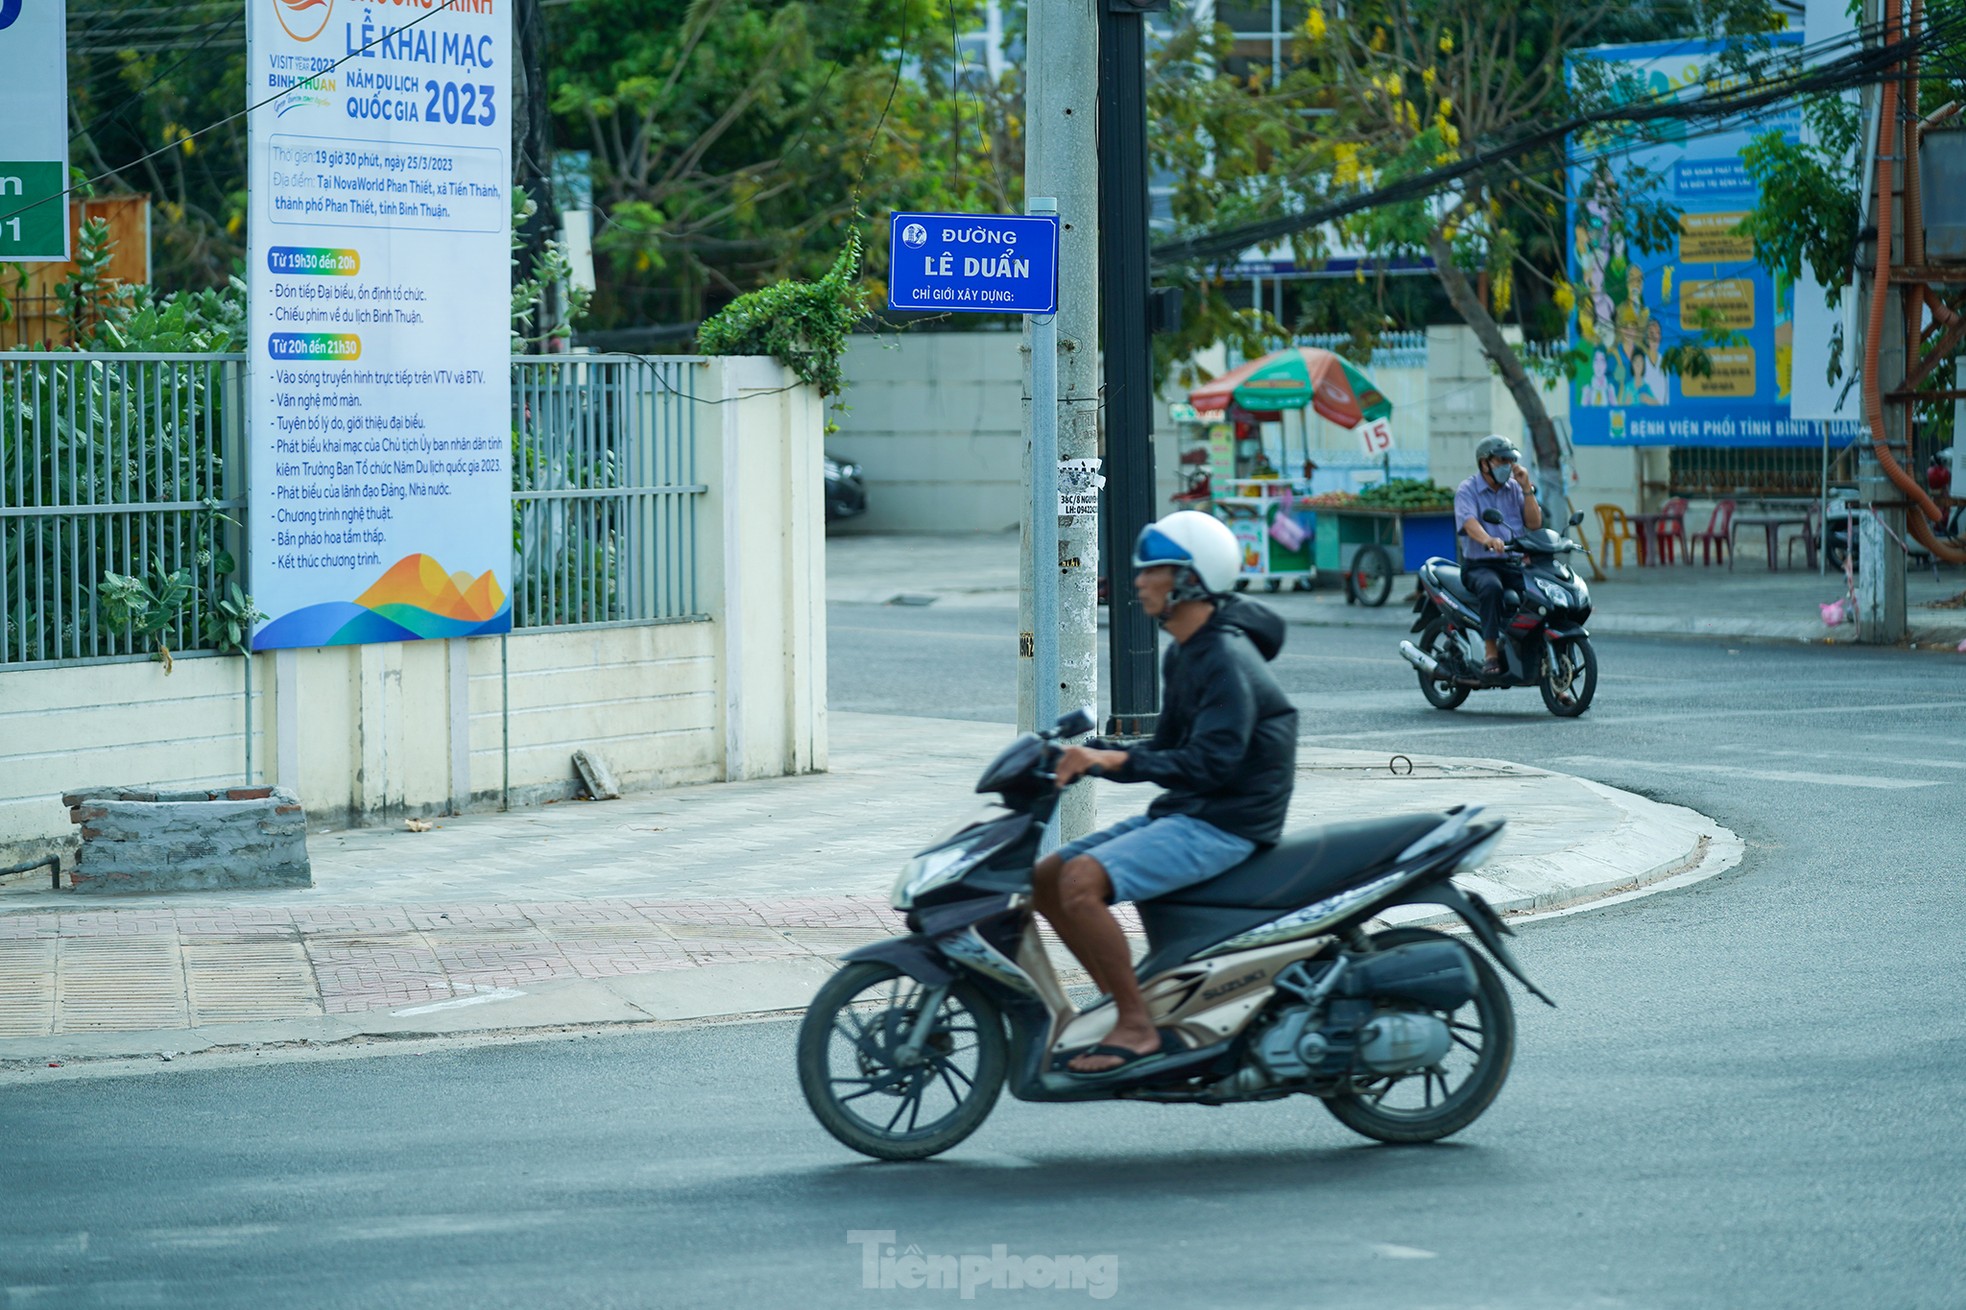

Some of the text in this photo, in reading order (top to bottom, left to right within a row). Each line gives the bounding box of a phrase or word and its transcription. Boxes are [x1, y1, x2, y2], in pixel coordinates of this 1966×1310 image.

[346, 8, 494, 74] LỄ KHAI MẠC
[269, 54, 336, 73] VISIT YEAR 2023
[269, 74, 336, 92] BINH THUAN
[347, 69, 419, 94] NĂM DU LỊCH
[346, 91, 392, 121] QUỐC
[395, 101, 419, 122] GIA
[425, 80, 496, 127] 2023
[316, 151, 327, 163] 19
[329, 151, 343, 169] giờ
[345, 153, 356, 165] 30
[358, 154, 382, 170] phút,
[384, 155, 405, 172] ngày
[407, 155, 453, 171] 25/3/2023
[317, 175, 330, 190] Tại
[334, 175, 384, 192] NovaWorld
[387, 179, 407, 193] Phan
[409, 179, 435, 196] Thiết,
[437, 182, 447, 195] xã
[449, 182, 467, 196] Tiến
[469, 184, 500, 199] Thành,
[275, 195, 450, 218] thành phố Phan Thiết, tỉnh Bình Thuận.
[942, 225, 1017, 244] ĐƯỜNG
[272, 252, 355, 269] Từ 19h30 đến 20h
[924, 248, 1030, 278] LÊ DUẨN
[275, 283, 426, 302] Đón tiếp Đại biểu, ổn định tổ chức.
[912, 285, 1014, 304] CHỈ GIỚI XÂY DỰNG:
[275, 306, 423, 326] Chiếu phim về du lịch Bình Thuận.
[272, 338, 357, 354] Từ 20h đến 21h30
[276, 370, 485, 387] Vào sóng truyền hình trực tiếp trên VTV và BTV.
[277, 392, 362, 410] Văn nghệ mở màn.
[277, 413, 425, 433] Tuyên bố lý do, giới thiệu đại biểu.
[1630, 420, 1665, 437] BỆNH
[1669, 420, 1699, 437] VIỆN
[1703, 414, 1736, 435] PHỔI
[1740, 415, 1771, 435] TỈNH
[277, 439, 300, 453] Phát
[302, 436, 321, 452] biểu
[323, 438, 341, 452] khai
[343, 440, 362, 454] mạc
[364, 437, 380, 451] của
[382, 438, 400, 451] Chủ
[403, 438, 418, 452] tịch
[433, 438, 449, 451] ban
[451, 438, 471, 451] nhân
[473, 437, 486, 450] dân
[488, 438, 502, 450] tỉnh
[1363, 423, 1390, 452] 15
[276, 458, 501, 479] kiêm Trưởng Ban Tổ chức Năm Du lịch quốc gia 2023.
[277, 481, 451, 501] Phát biểu của lãnh đạo Đảng, Nhà nước.
[277, 506, 393, 525] Chương trình nghệ thuật.
[278, 527, 386, 548] Bắn pháo hoa tầm thấp.
[278, 551, 381, 569] Kết thúc chương trình.
[1202, 969, 1266, 1001] SUZUKI
